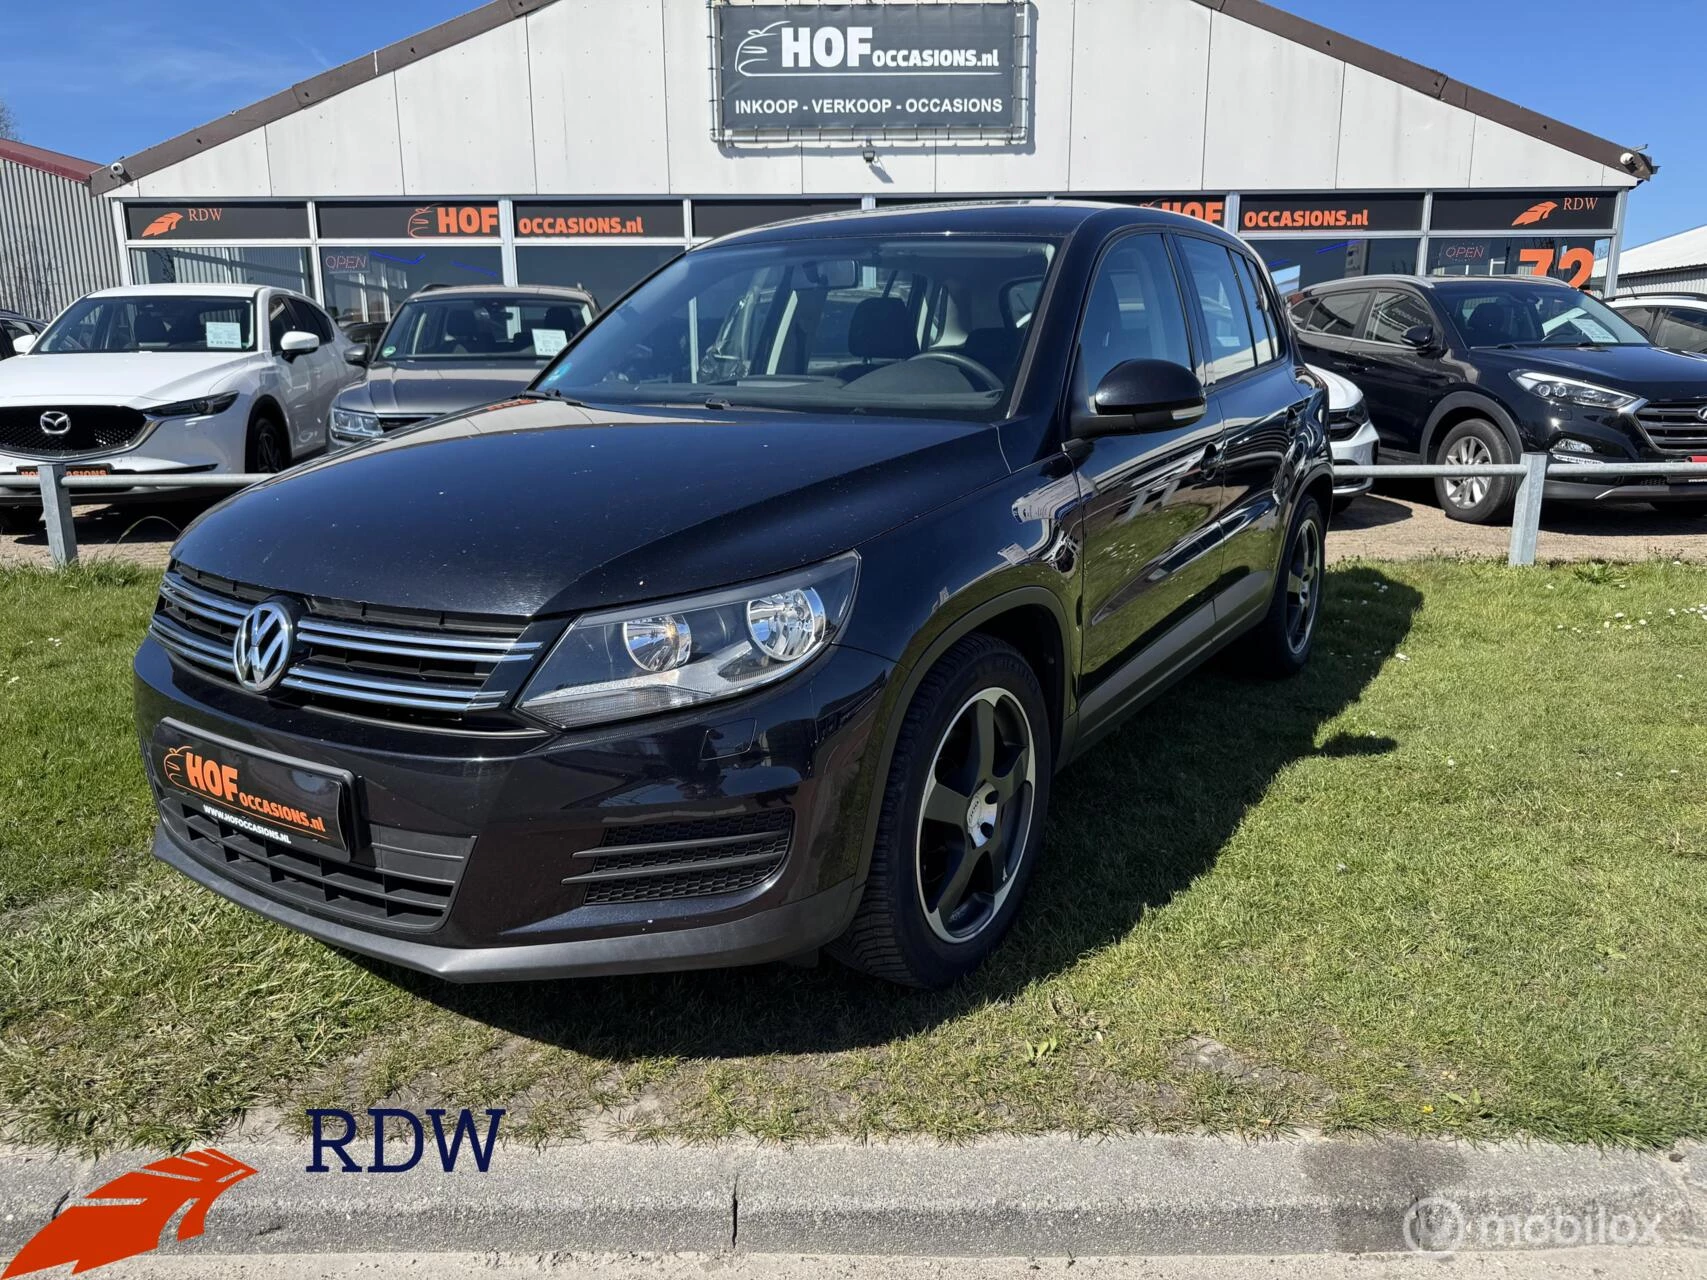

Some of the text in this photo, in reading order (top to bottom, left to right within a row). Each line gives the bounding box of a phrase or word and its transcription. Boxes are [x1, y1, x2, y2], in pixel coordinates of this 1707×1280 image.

[781, 26, 1000, 68] HOF OCCASIONS.nl
[735, 99, 798, 114] INKOOP
[812, 99, 892, 114] VERKOOP
[905, 98, 1002, 113] OCCASIONS
[1562, 197, 1599, 211] RDW
[187, 208, 223, 222] RDW
[436, 206, 644, 235] HOF OCCASIONS.nl
[1244, 209, 1369, 228] OCCASIONS.nl
[325, 255, 367, 269] OPEN
[1445, 246, 1485, 259] OPEN
[1519, 247, 1595, 290] 72
[185, 752, 326, 833] HOF OCCASIONS.nl
[203, 804, 292, 845] WWW.HOFOCCASIONS.NL
